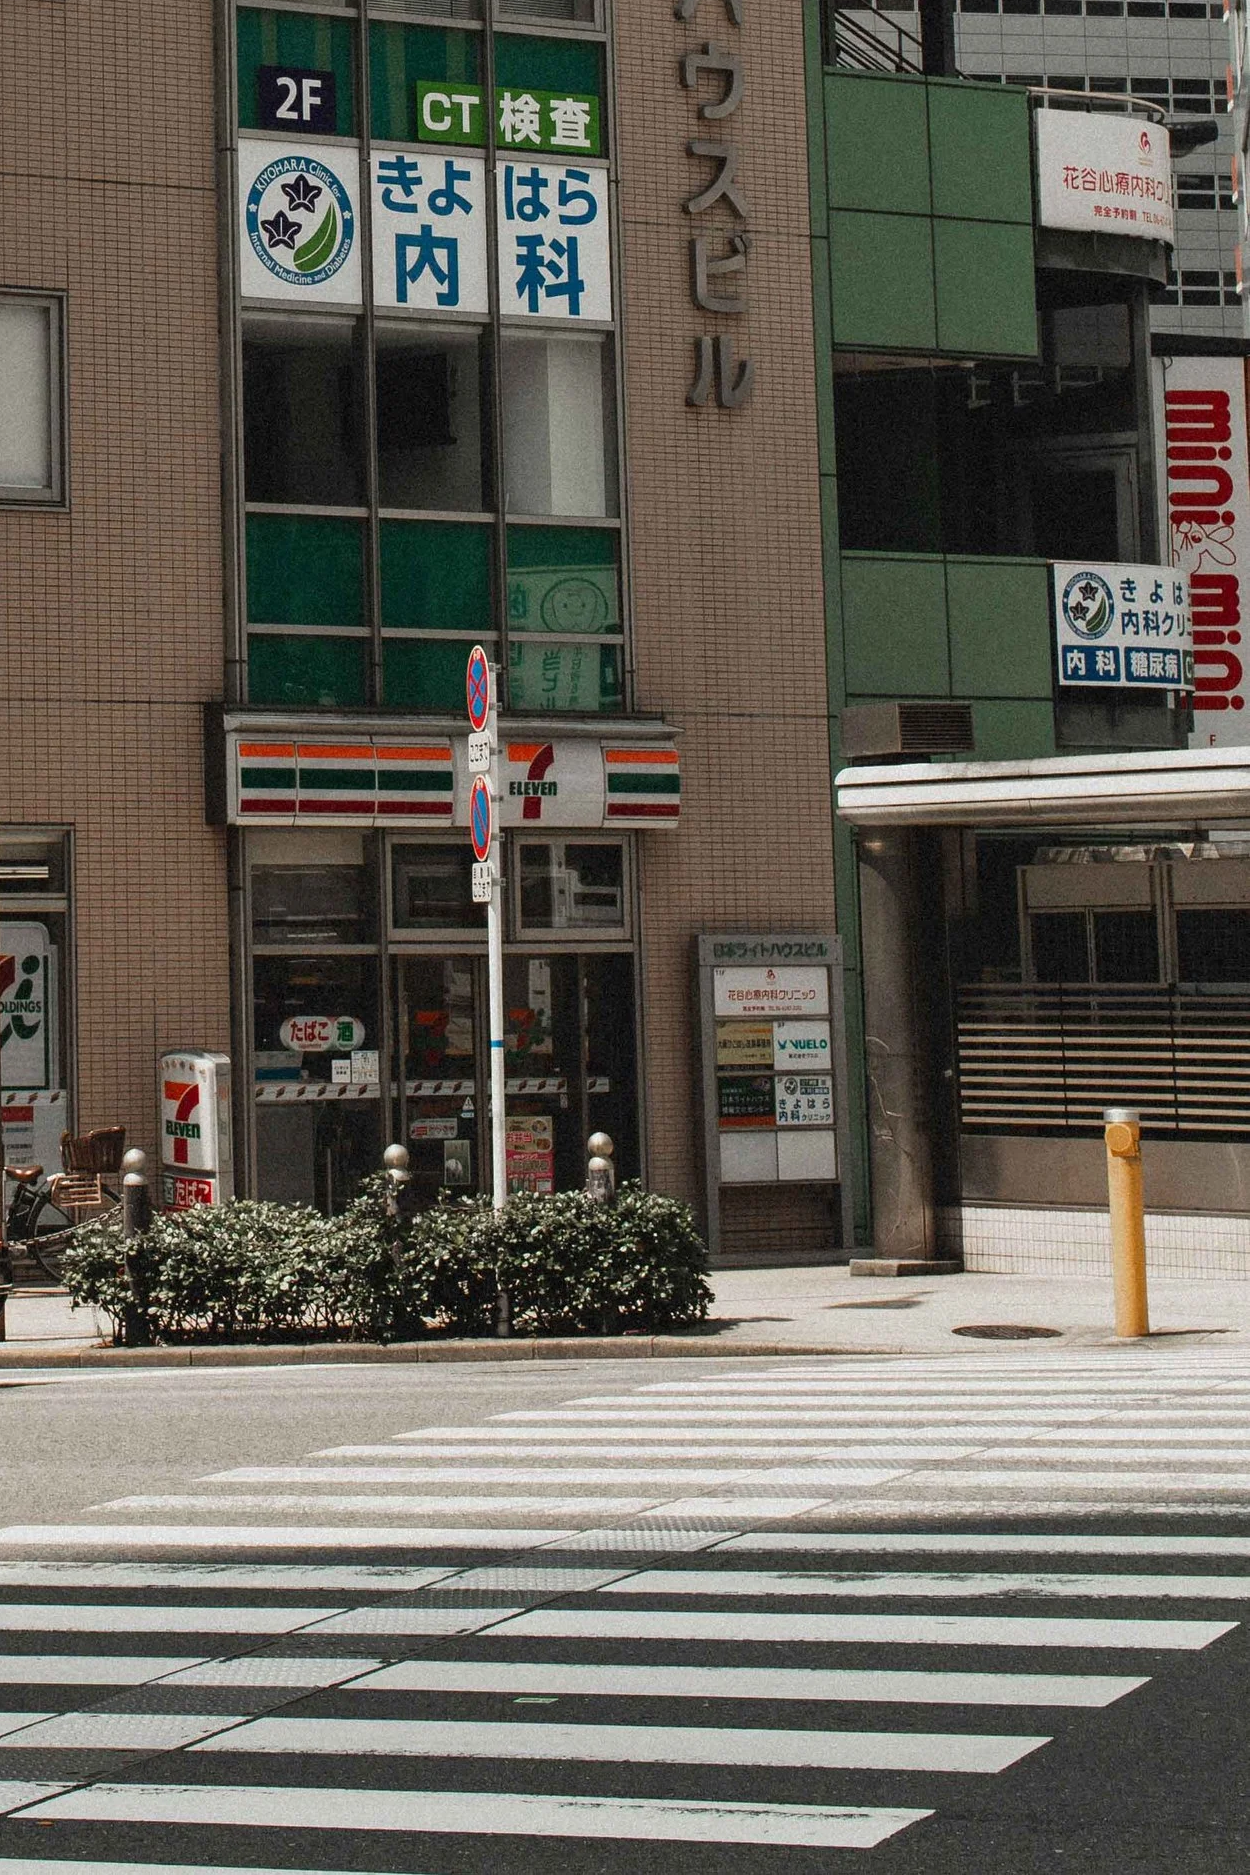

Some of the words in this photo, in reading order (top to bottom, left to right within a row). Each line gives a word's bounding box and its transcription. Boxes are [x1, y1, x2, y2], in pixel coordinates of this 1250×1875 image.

[275, 76, 322, 122] 2F
[422, 91, 592, 149] CT検査
[254, 158, 306, 193] KIYOHARA
[309, 162, 334, 186] Clinic
[330, 183, 342, 199] for
[376, 154, 599, 225] きよはら
[250, 232, 275, 270] Internal
[273, 264, 313, 285] Medicine
[314, 271, 326, 283] and
[326, 237, 352, 277] Diabetes
[394, 224, 586, 317] 内科
[1066, 649, 1117, 676] 内科
[1130, 650, 1179, 679] 糖尿病
[713, 942, 828, 958] 日本ライトハウスビル
[290, 1020, 330, 1043] たばこ
[336, 1021, 355, 1042] 酒
[790, 1039, 828, 1050] VUELO
[778, 1098, 831, 1110] きよはら
